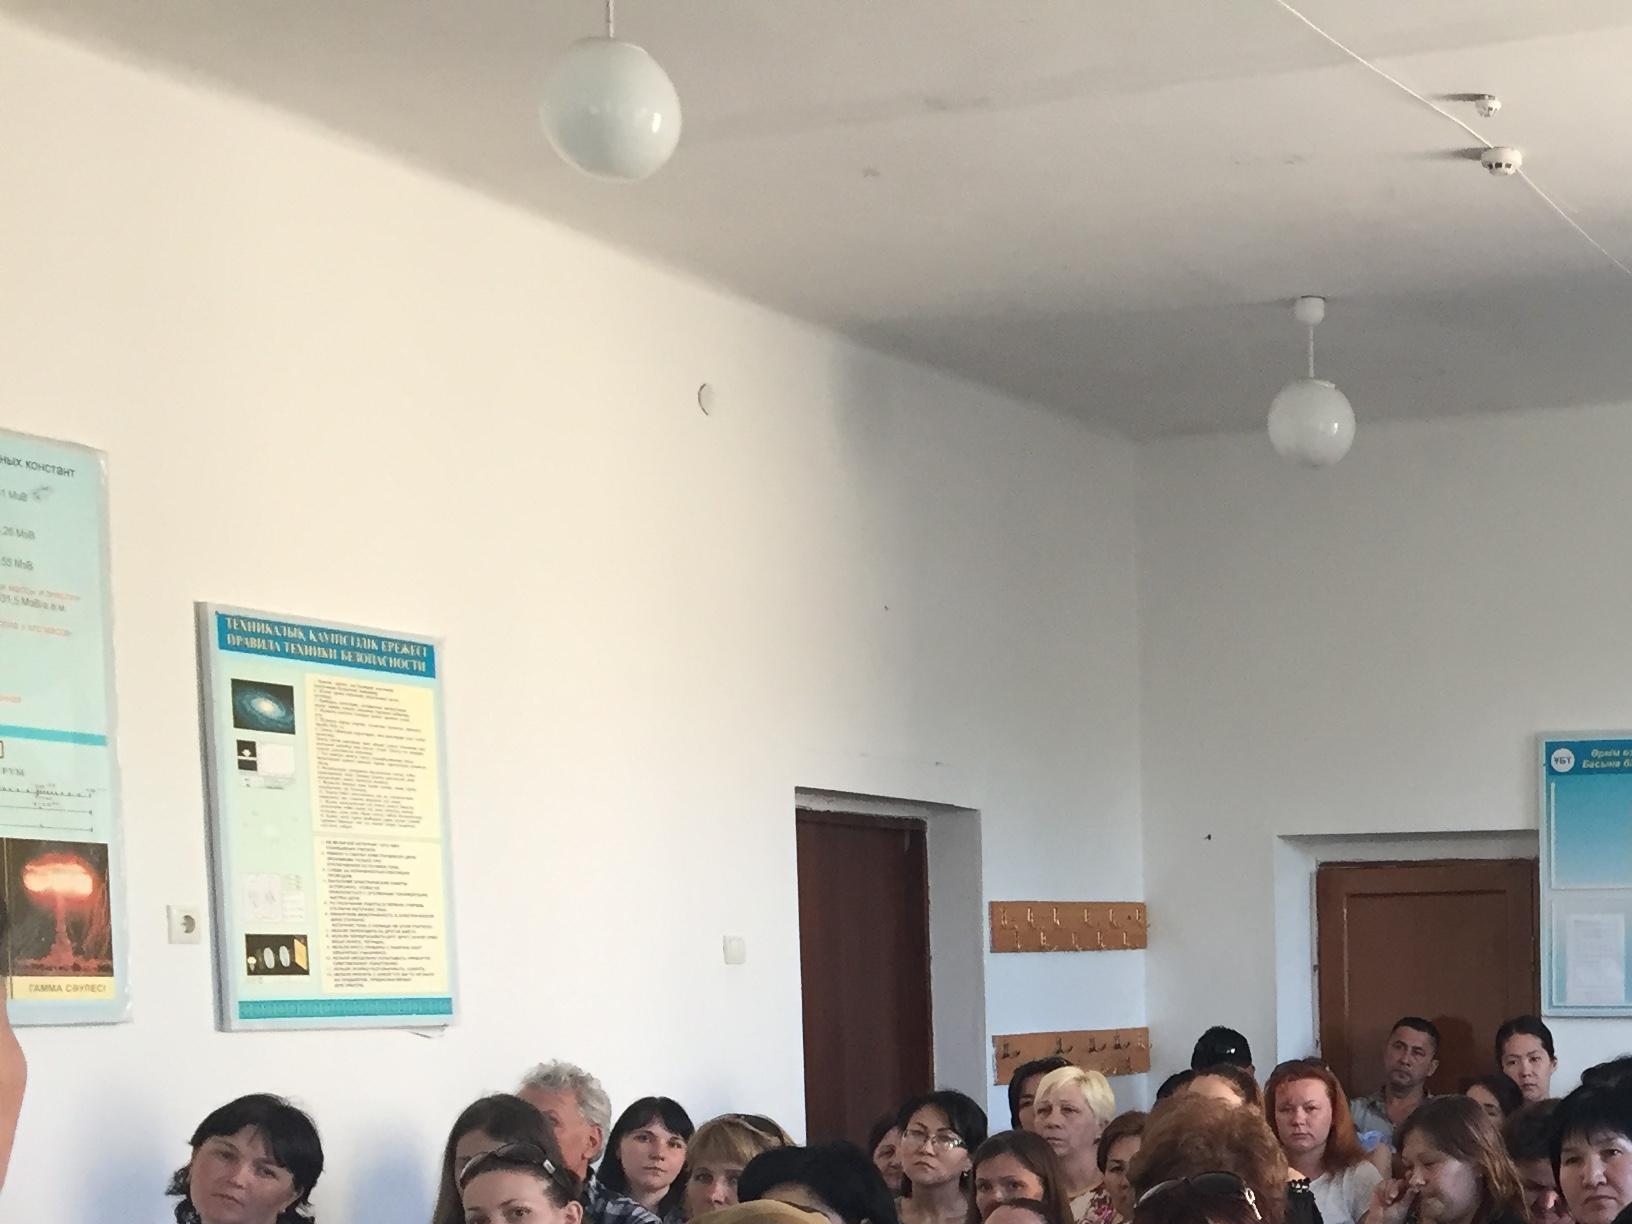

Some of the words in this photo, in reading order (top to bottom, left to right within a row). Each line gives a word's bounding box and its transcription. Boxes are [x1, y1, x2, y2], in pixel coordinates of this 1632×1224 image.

[227, 633, 281, 653] ПРАВИЛА
[284, 641, 337, 661] ТЕХНИКИ
[341, 651, 426, 673] БЕЗОПАСНОСТИ
